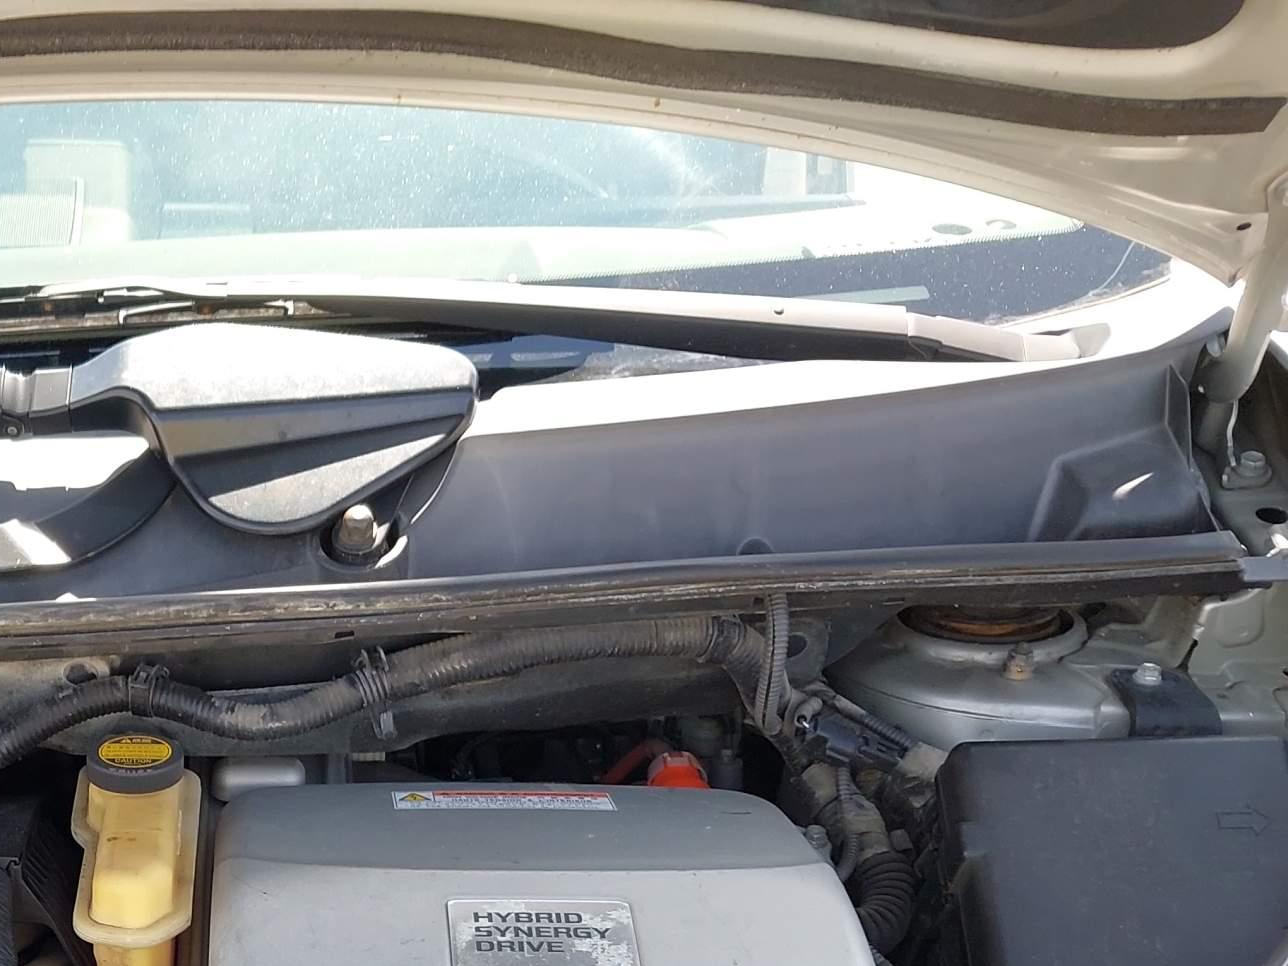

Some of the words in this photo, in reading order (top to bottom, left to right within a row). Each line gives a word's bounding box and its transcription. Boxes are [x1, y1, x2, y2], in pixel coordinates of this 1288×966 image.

[473, 912, 583, 924] HYBRID
[475, 926, 611, 939] SYNERGY
[476, 940, 565, 953] DRIVE
